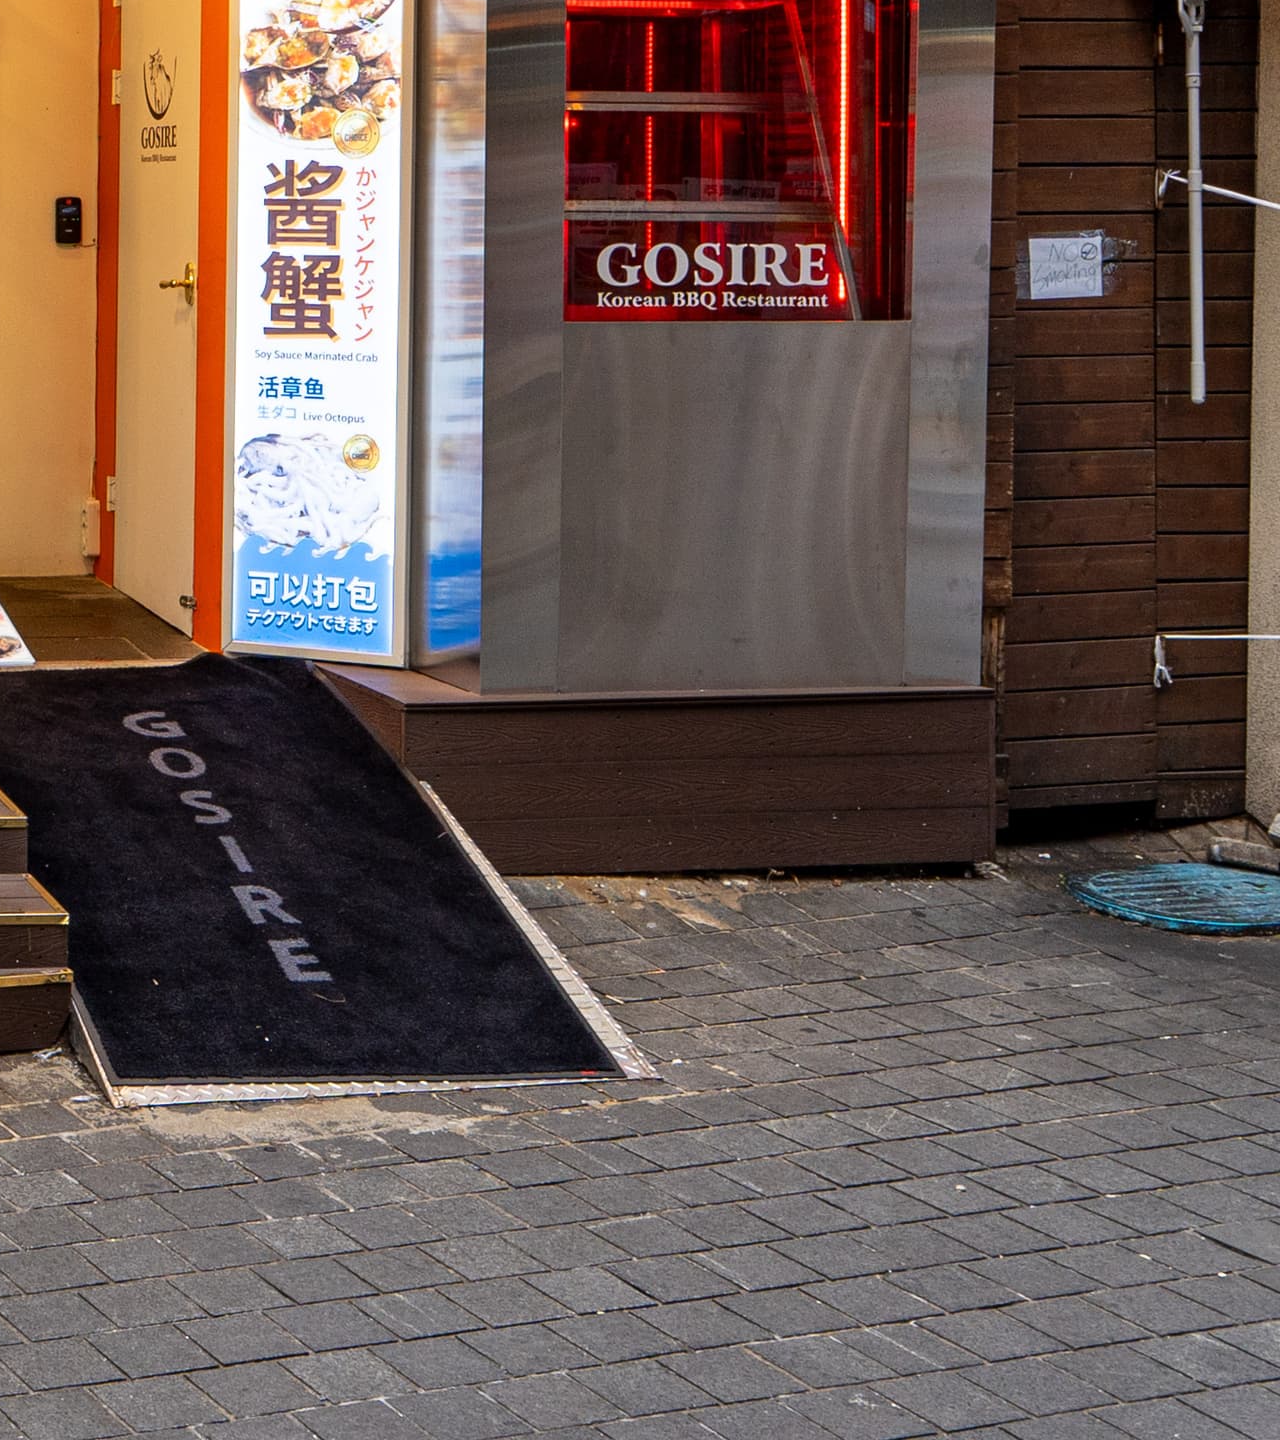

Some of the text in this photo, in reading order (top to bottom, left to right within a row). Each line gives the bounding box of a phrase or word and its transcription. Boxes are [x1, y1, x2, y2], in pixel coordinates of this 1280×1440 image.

[141, 125, 177, 149] GOSIRE
[595, 242, 830, 287] GOSIRE
[1048, 243, 1079, 262] NO
[596, 290, 829, 310] Korean BBQ Restaurant
[255, 349, 378, 362] Soy Sauce Marinated Crab
[258, 376, 325, 400] 活章鱼
[303, 412, 365, 424] Live Octopus
[247, 569, 378, 613] 可以打包
[123, 711, 333, 982] GOSIRE
